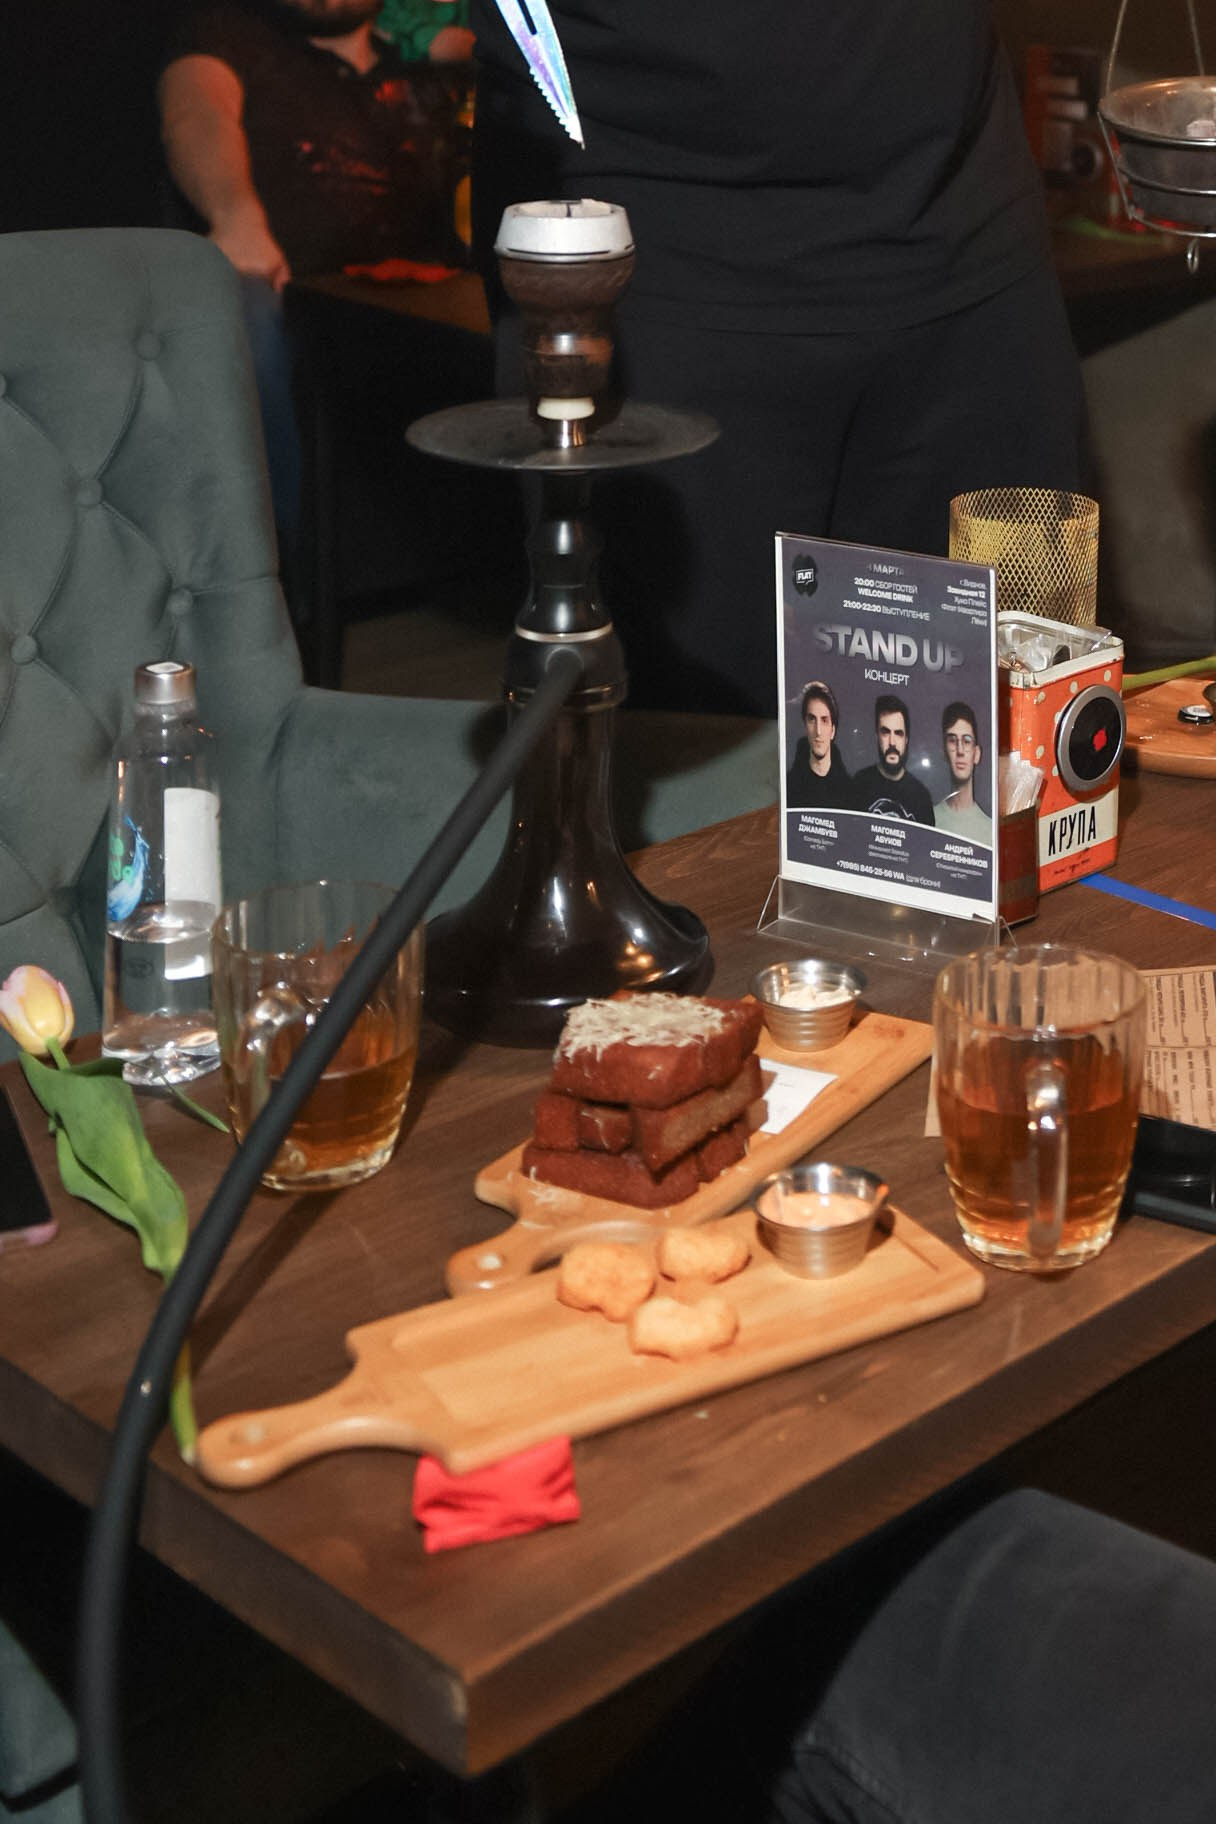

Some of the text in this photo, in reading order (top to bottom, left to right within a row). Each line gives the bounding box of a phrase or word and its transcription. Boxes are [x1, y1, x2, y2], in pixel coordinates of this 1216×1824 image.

[854, 577, 875, 588] 20:00
[858, 587, 892, 600] WELCOME
[882, 605, 930, 622] ВЫСТУПЛЕНИЕ
[813, 624, 966, 674] STAND UP
[864, 668, 910, 686] КОНЦЕРТ
[801, 814, 835, 830] МАГОМЕД
[871, 824, 906, 840] МАГОМЕД
[1048, 805, 1096, 857] КРУПА
[944, 843, 974, 857] АНДРЕЙ
[929, 850, 989, 869] СЕРЕБРЕННИКОВ
